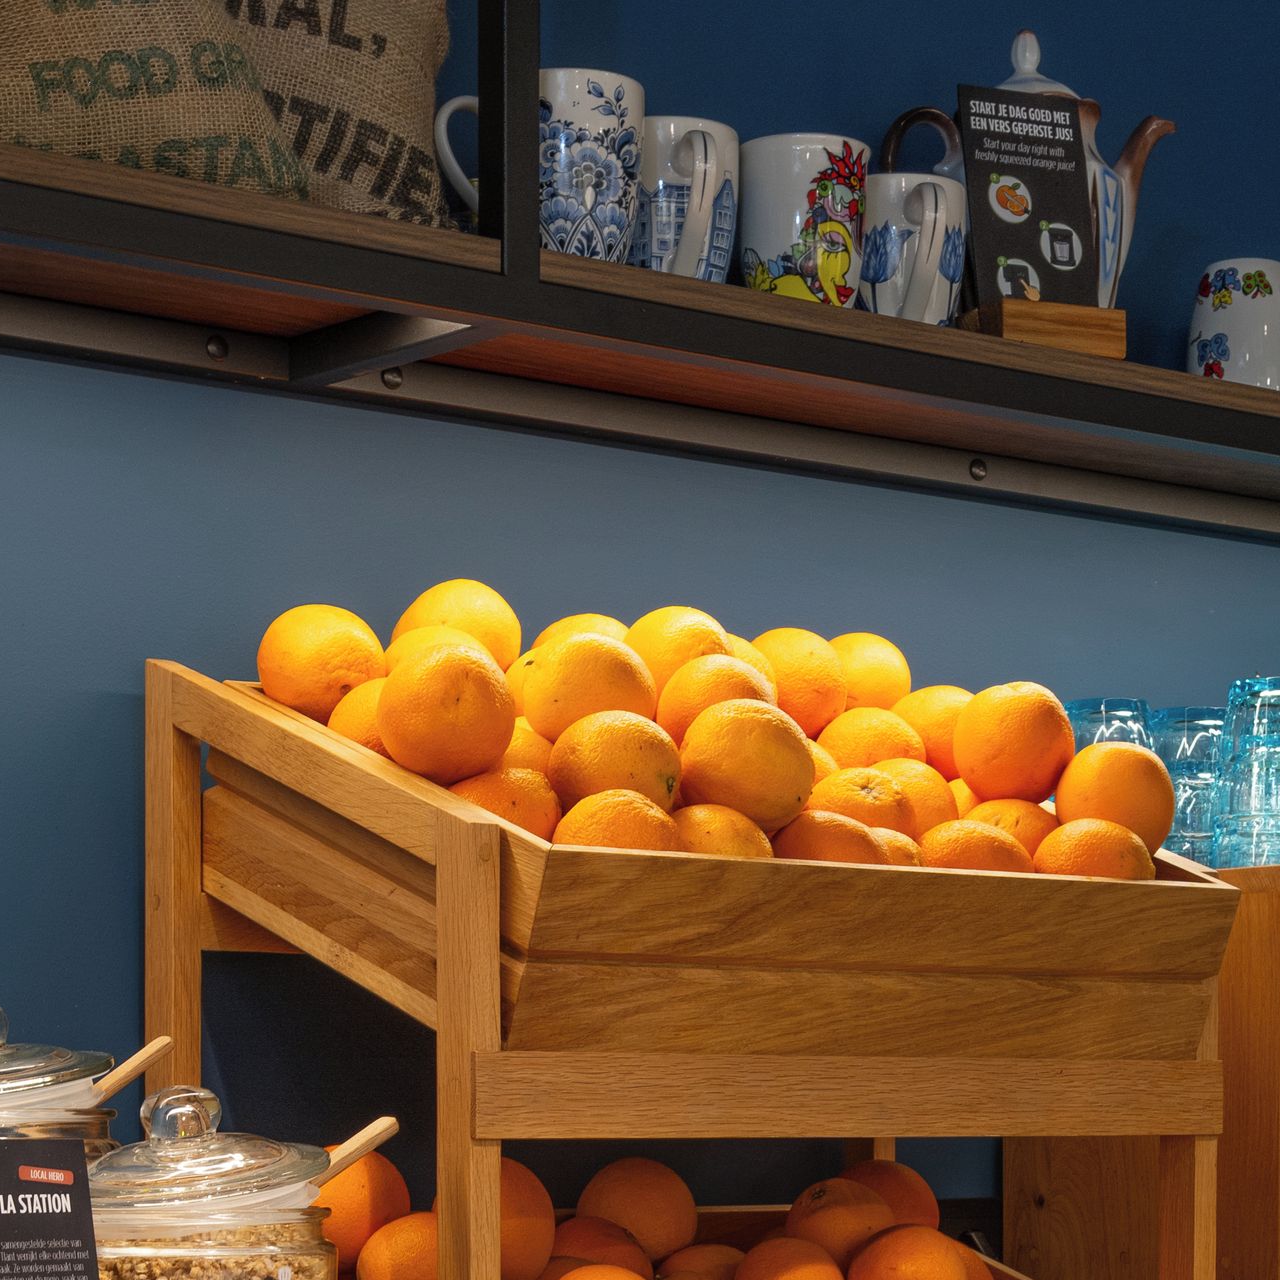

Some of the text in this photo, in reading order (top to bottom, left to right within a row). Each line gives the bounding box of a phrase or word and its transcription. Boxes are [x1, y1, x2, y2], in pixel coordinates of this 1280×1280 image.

[29, 46, 178, 111] FOOD
[970, 100, 1070, 125] START JE DAG GOED MET
[970, 116, 1074, 141] EEN VERS GEPERSTE JUS!
[983, 138, 1064, 157] Start your day right with
[975, 149, 1075, 171] freshly squeezed orange juice!
[30, 1169, 64, 1181] LOCAL HERO
[20, 1194, 71, 1213] STATION
[77, 1250, 89, 1259] met
